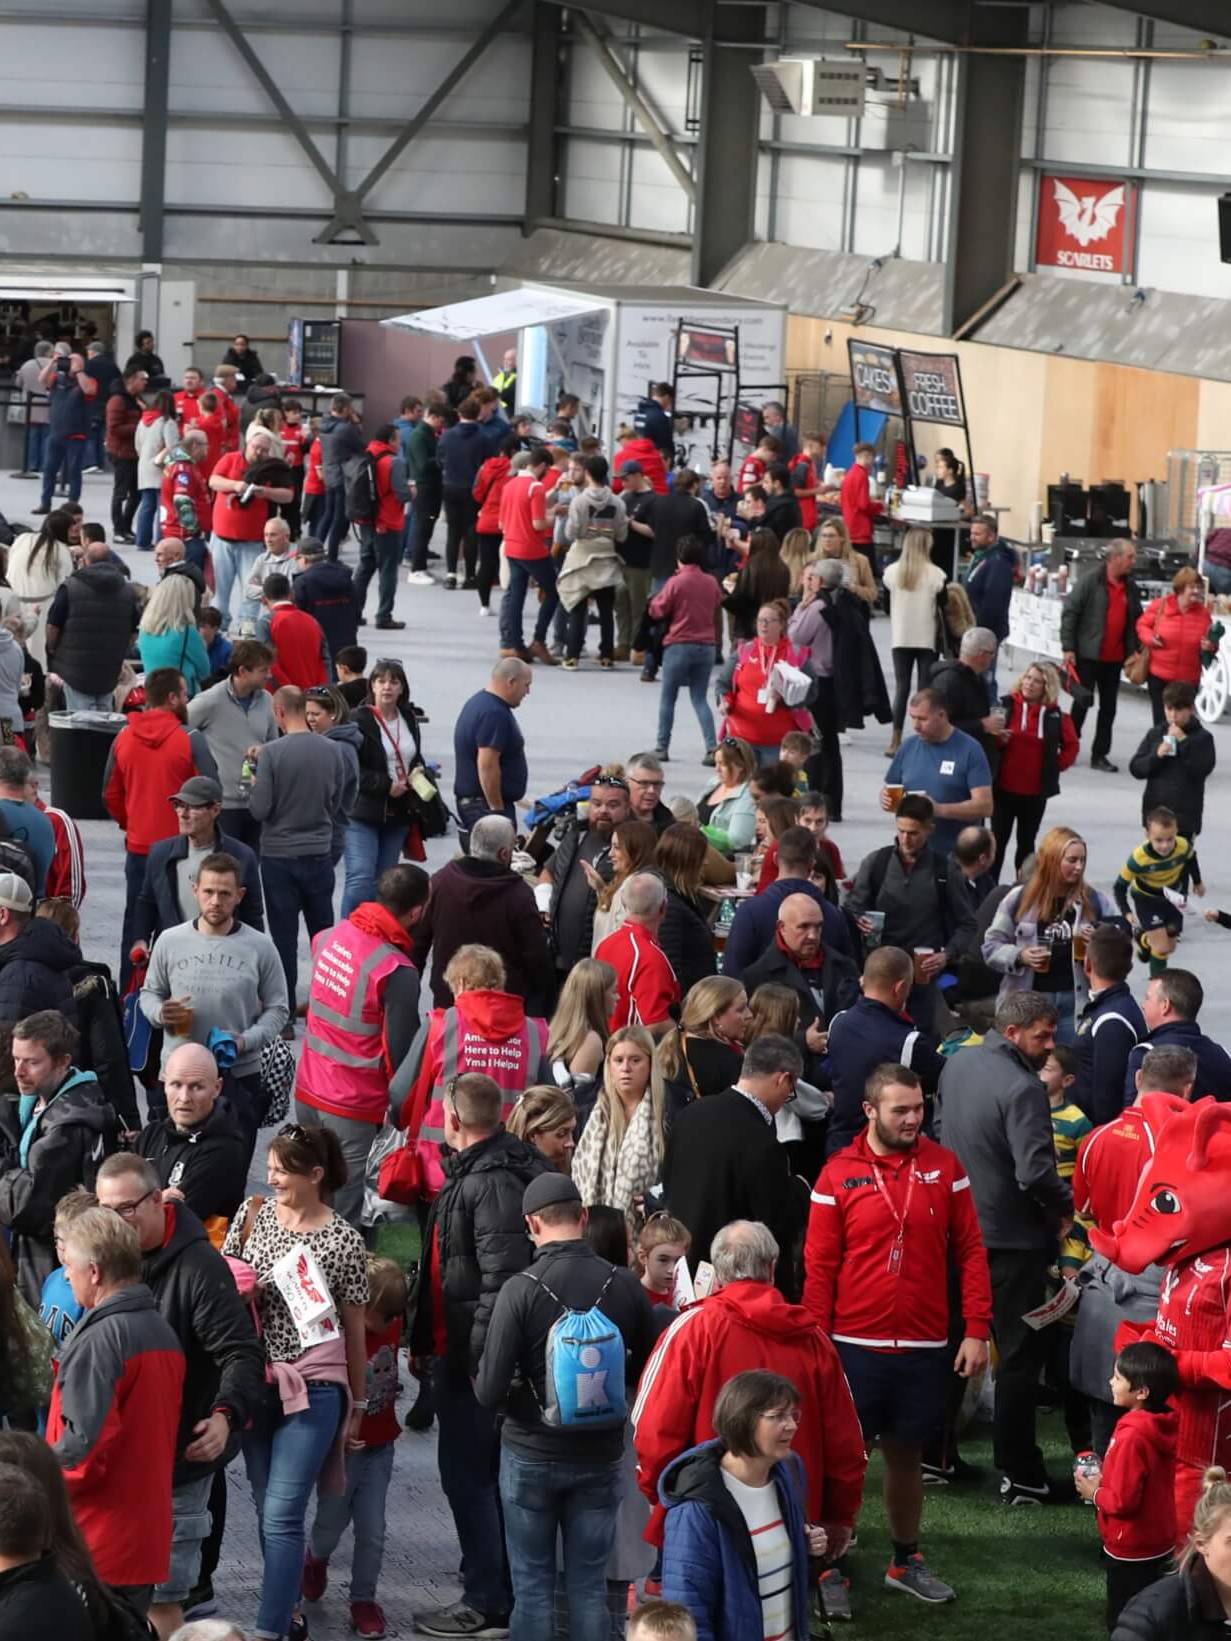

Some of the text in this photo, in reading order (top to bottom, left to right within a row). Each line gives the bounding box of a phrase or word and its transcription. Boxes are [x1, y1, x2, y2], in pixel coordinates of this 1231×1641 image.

[1057, 250, 1114, 271] SCARLETS
[856, 364, 891, 393] CAKES
[913, 372, 947, 393] FRESH
[911, 391, 958, 419] COFFEE
[318, 960, 329, 973] Here
[336, 972, 351, 987] Help
[464, 1045, 522, 1058] Here to Help
[465, 1058, 487, 1068] Yma
[493, 1059, 519, 1070] Helpu
